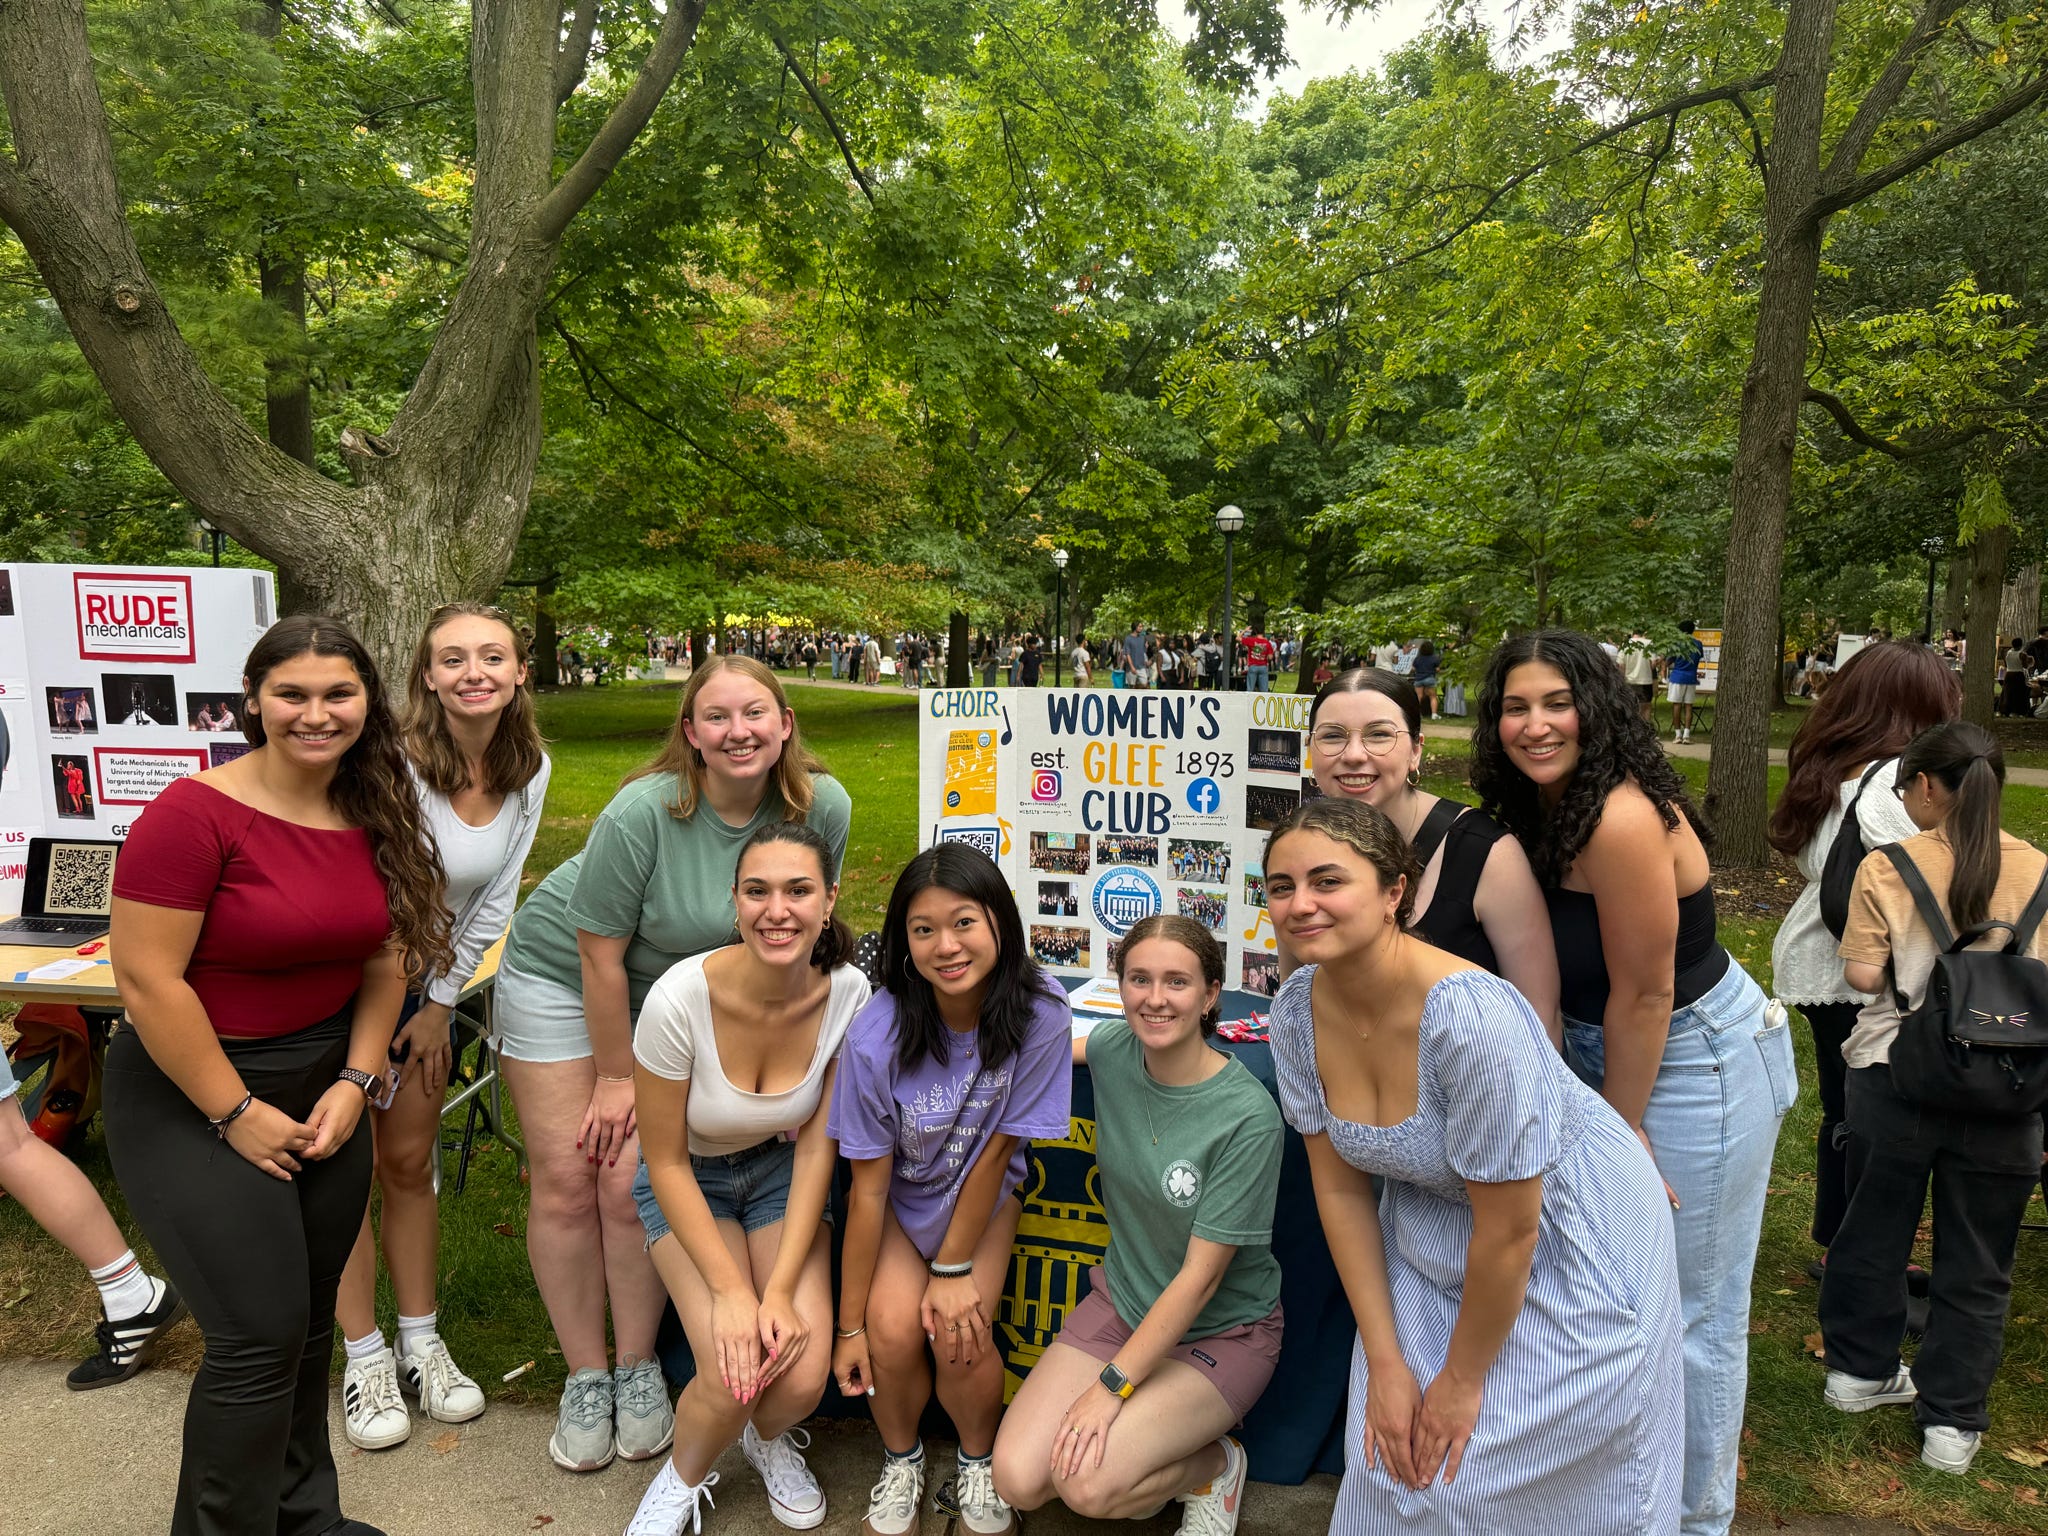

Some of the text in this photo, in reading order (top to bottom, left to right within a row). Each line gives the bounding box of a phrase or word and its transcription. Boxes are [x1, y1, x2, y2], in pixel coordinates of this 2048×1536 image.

[86, 594, 179, 626] RUDE
[85, 620, 186, 639] mechanicals
[930, 690, 1001, 718] CHOIR
[1047, 693, 1221, 740] WOMEN'S
[110, 758, 128, 766] Rude
[129, 759, 170, 767] Mechanicals
[178, 760, 189, 768] the
[1030, 747, 1069, 769] est.
[1083, 741, 1166, 787] GLEE
[1175, 751, 1235, 778] 1893
[106, 777, 131, 786] largest
[132, 778, 145, 786] and
[146, 779, 166, 787] oldest
[110, 768, 190, 779] University of Michigan's
[123, 788, 148, 796] theatre
[1081, 790, 1172, 835] CLUB
[6, 832, 25, 843] US
[1100, 867, 1136, 886] MICHIGAN
[363, 1359, 385, 1370] adidas
